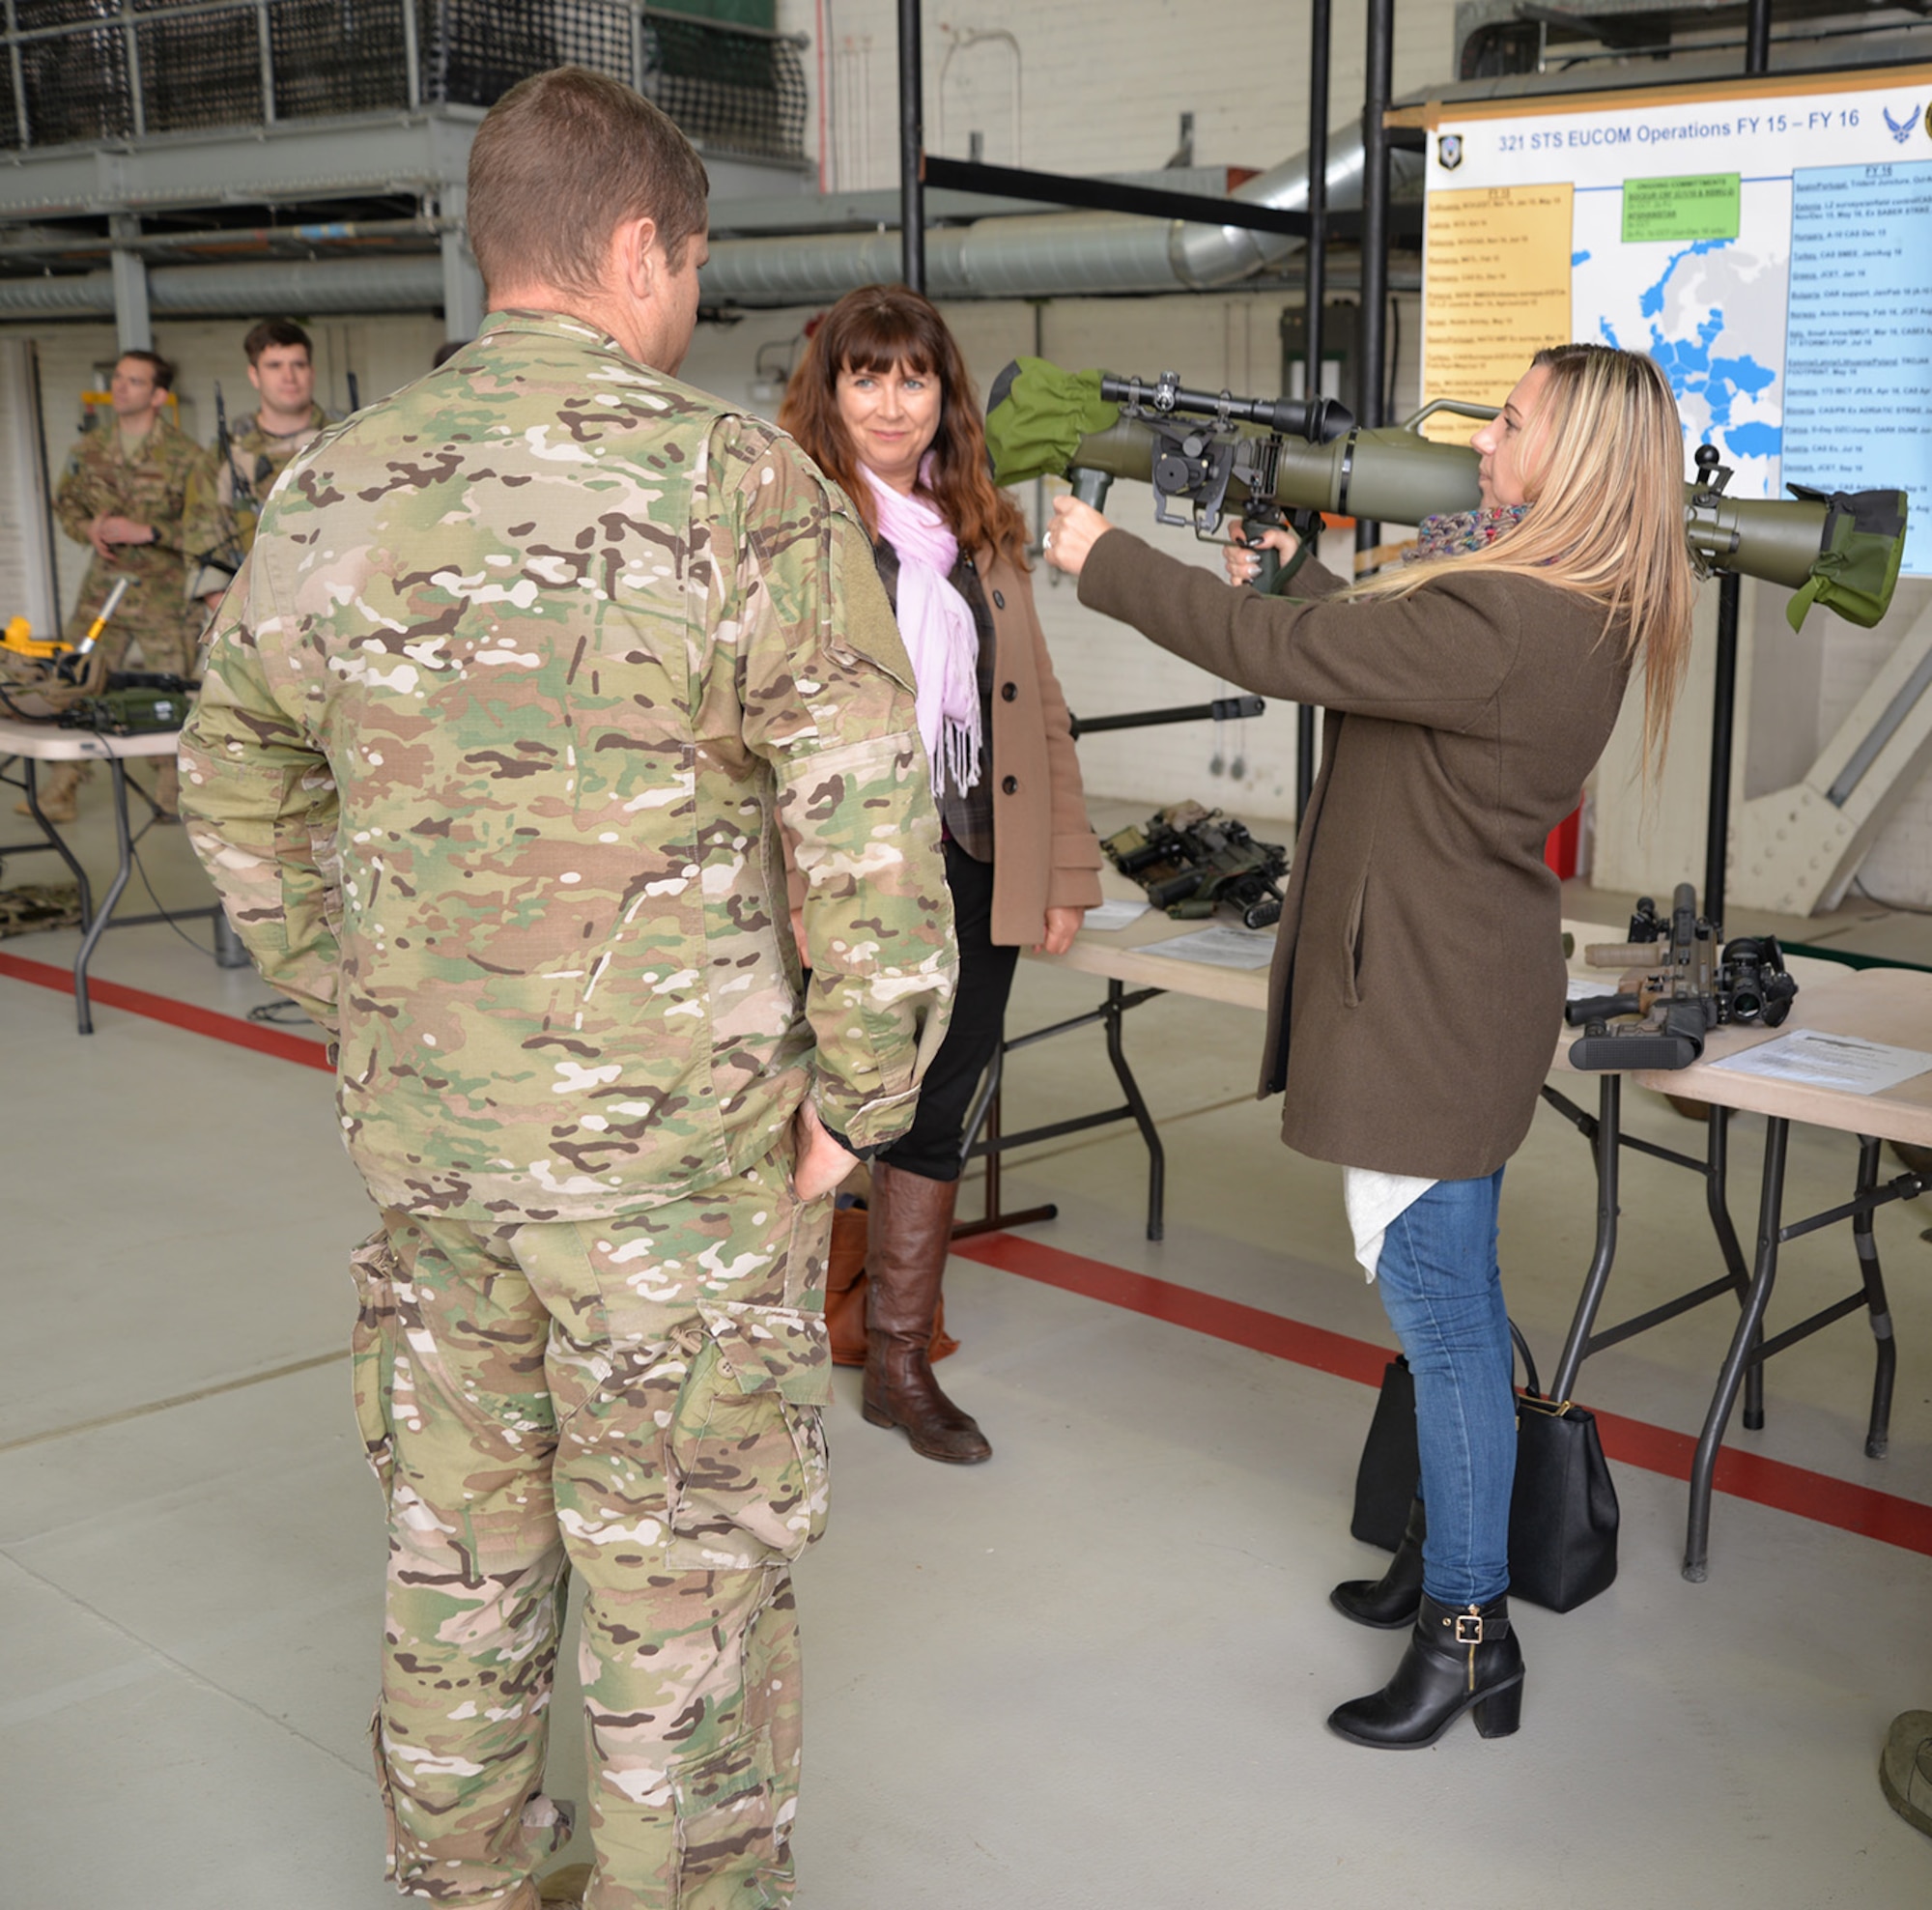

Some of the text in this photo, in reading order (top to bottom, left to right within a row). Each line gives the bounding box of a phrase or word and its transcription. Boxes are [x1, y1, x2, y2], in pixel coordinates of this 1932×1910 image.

[1499, 134, 1524, 152] 321
[1530, 131, 1564, 150] STS
[1568, 126, 1632, 147] EUCOM
[1635, 121, 1732, 145] Operations
[1736, 117, 1760, 135] FY
[1767, 114, 1788, 132] 15
[1807, 110, 1833, 130] FY
[1838, 108, 1860, 128] 16
